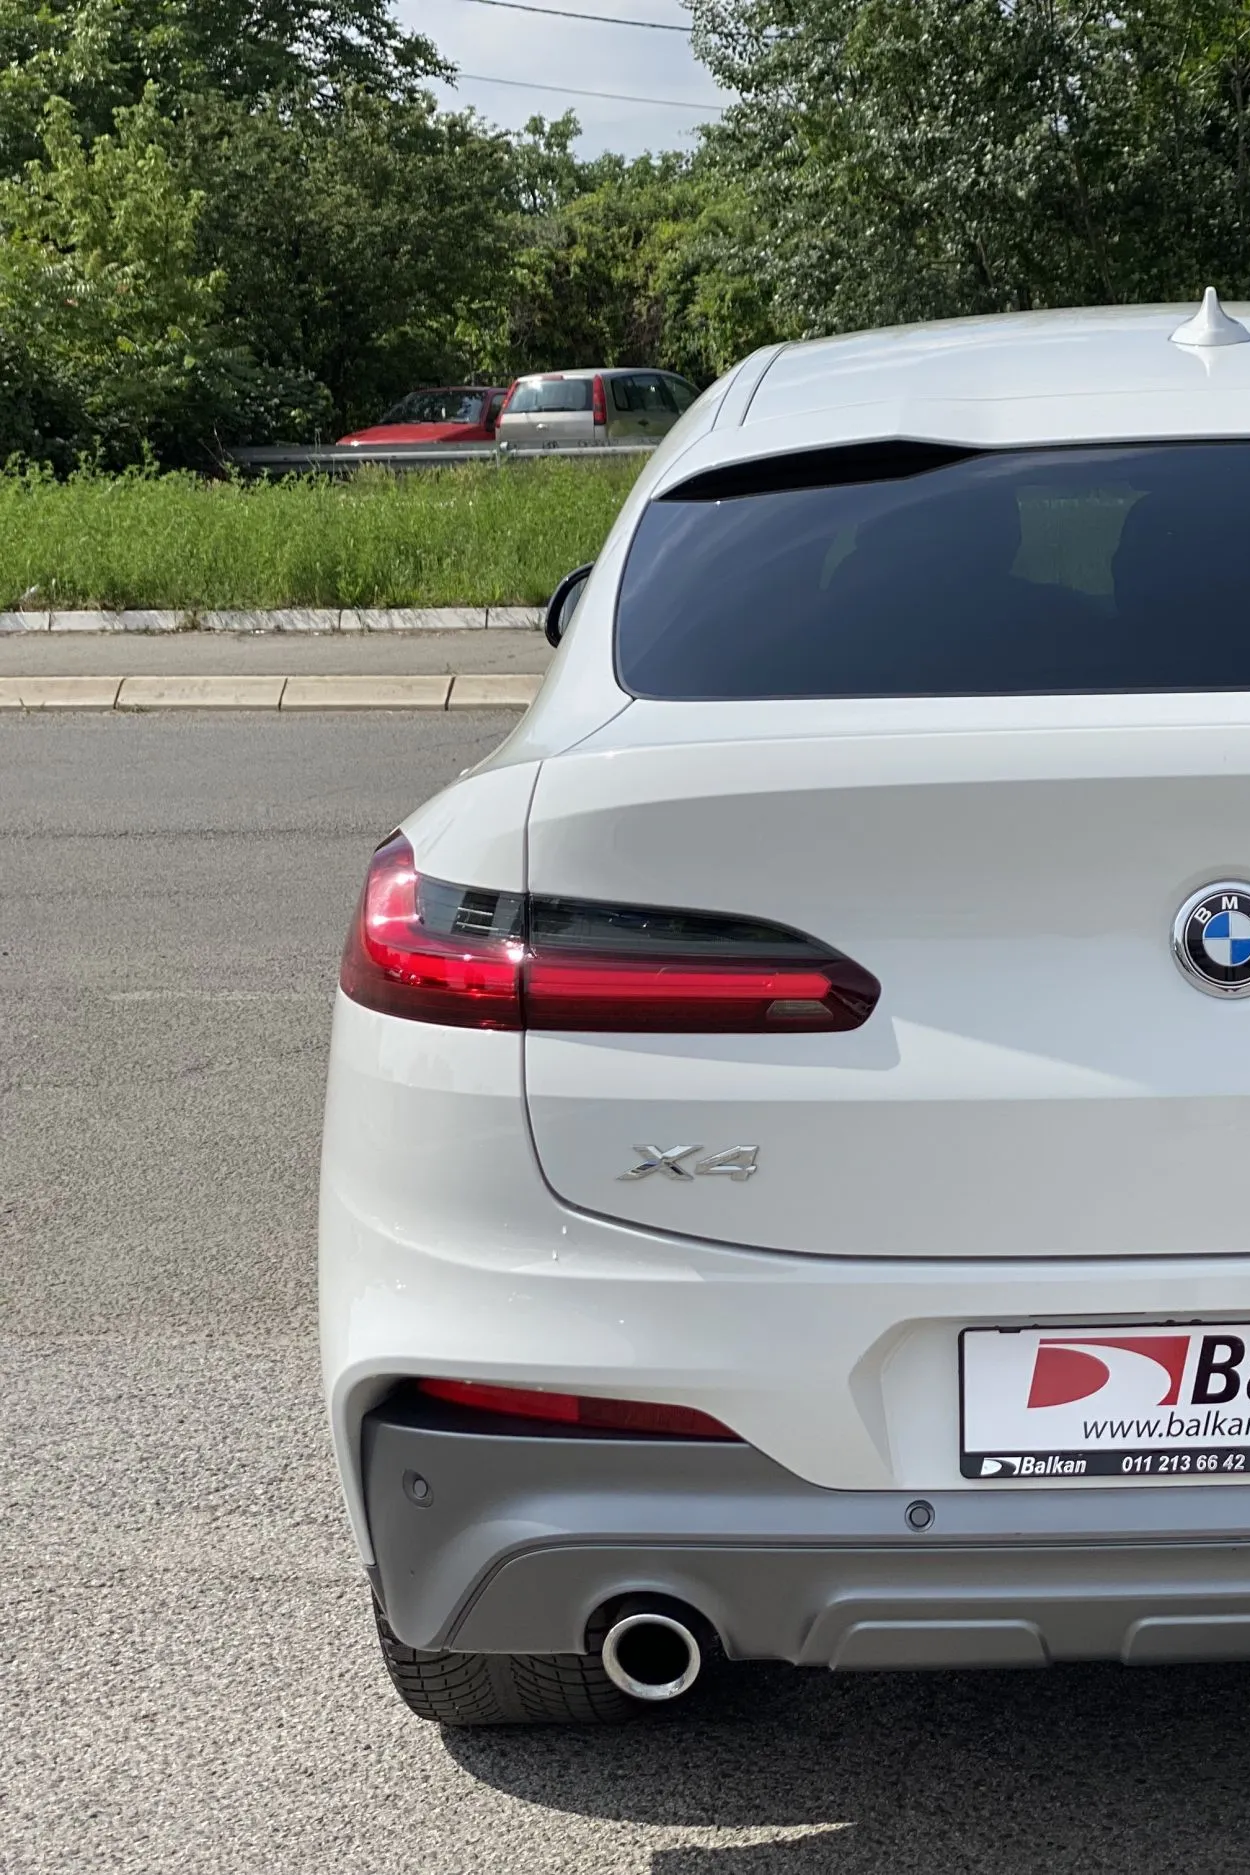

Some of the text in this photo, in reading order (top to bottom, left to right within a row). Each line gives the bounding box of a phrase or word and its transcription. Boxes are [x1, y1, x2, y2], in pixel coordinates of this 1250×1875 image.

[615, 1144, 760, 1181] X4
[1020, 1456, 1087, 1475] Balkan
[1121, 1455, 1152, 1472] 011
[1158, 1455, 1191, 1472] 213
[1196, 1454, 1218, 1471] 66
[1222, 1454, 1246, 1470] 42
